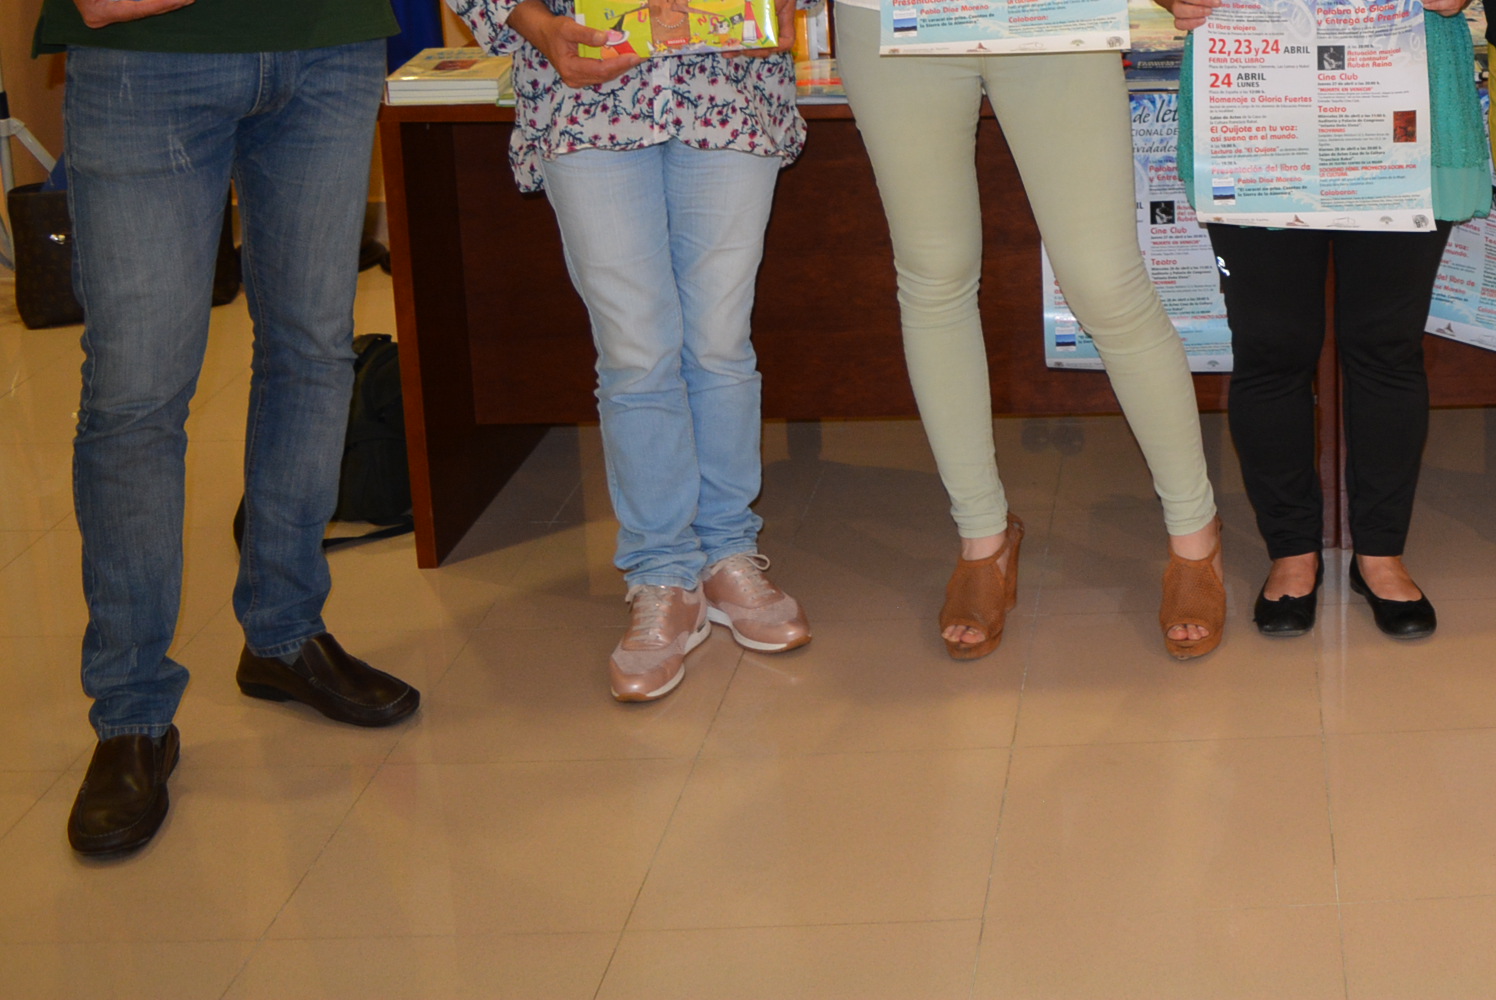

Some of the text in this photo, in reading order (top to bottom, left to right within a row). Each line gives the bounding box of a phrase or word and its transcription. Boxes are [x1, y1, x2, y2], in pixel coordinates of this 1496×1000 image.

[1354, 6, 1366, 14] de
[1369, 4, 1395, 13] Gloria
[1325, 17, 1360, 26] Entrega
[1234, 39, 1252, 55] 23
[1254, 47, 1260, 56] y
[1261, 39, 1280, 55] 24
[1283, 46, 1311, 54] ABRIL
[1209, 73, 1266, 88] 24 ABRIL
[1209, 96, 1249, 104] Homenaje
[1133, 106, 1151, 124] de
[1220, 125, 1253, 135] Quijote
[1170, 226, 1187, 234] Club
